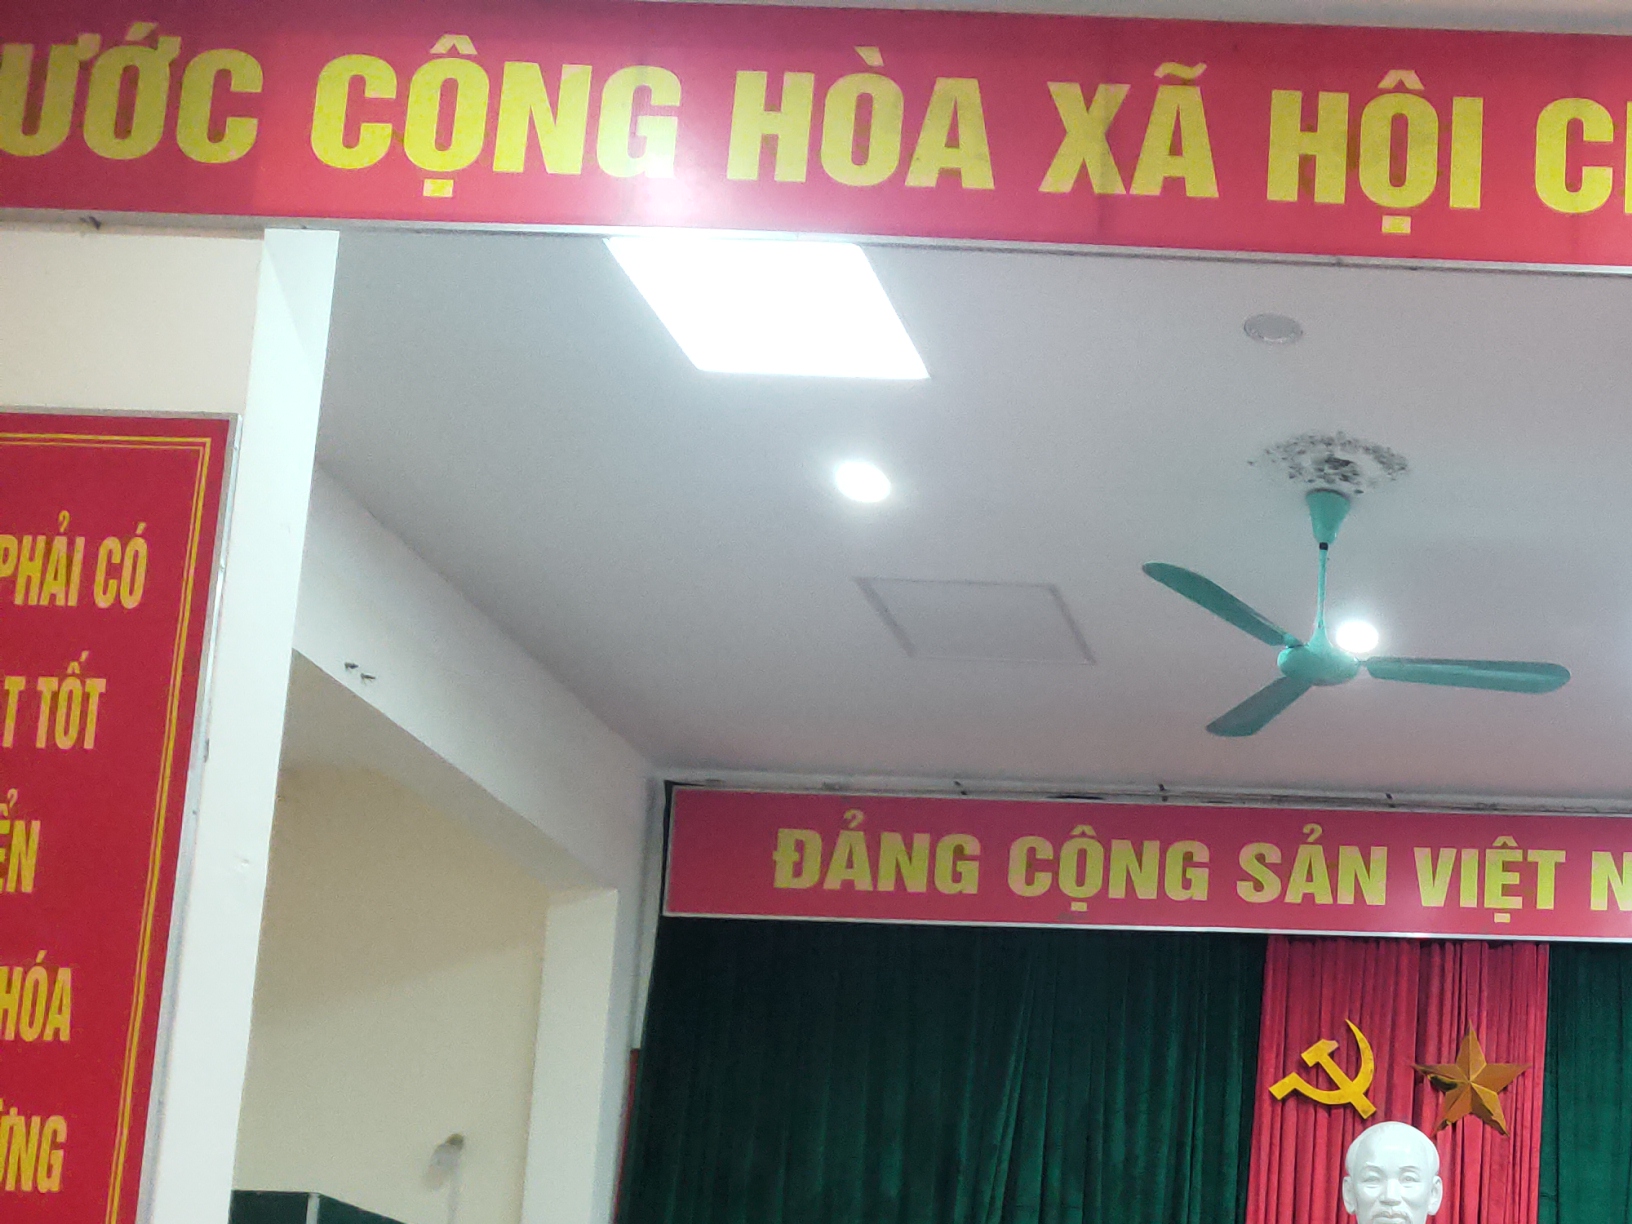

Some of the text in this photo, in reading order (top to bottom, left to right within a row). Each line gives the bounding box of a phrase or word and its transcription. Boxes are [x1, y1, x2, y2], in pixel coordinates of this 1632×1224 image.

[311, 33, 682, 198] CỘNG
[726, 45, 995, 190] HÒA
[1038, 61, 1219, 198] XÃ
[1267, 69, 1484, 234] HỘI
[93, 521, 148, 609] CÓ
[36, 650, 106, 750] TỐT
[773, 809, 982, 894] ĐẢNG
[1006, 824, 1209, 913] CỘNG
[1236, 822, 1388, 907] SẢN
[1412, 834, 1565, 924] VIỆT
